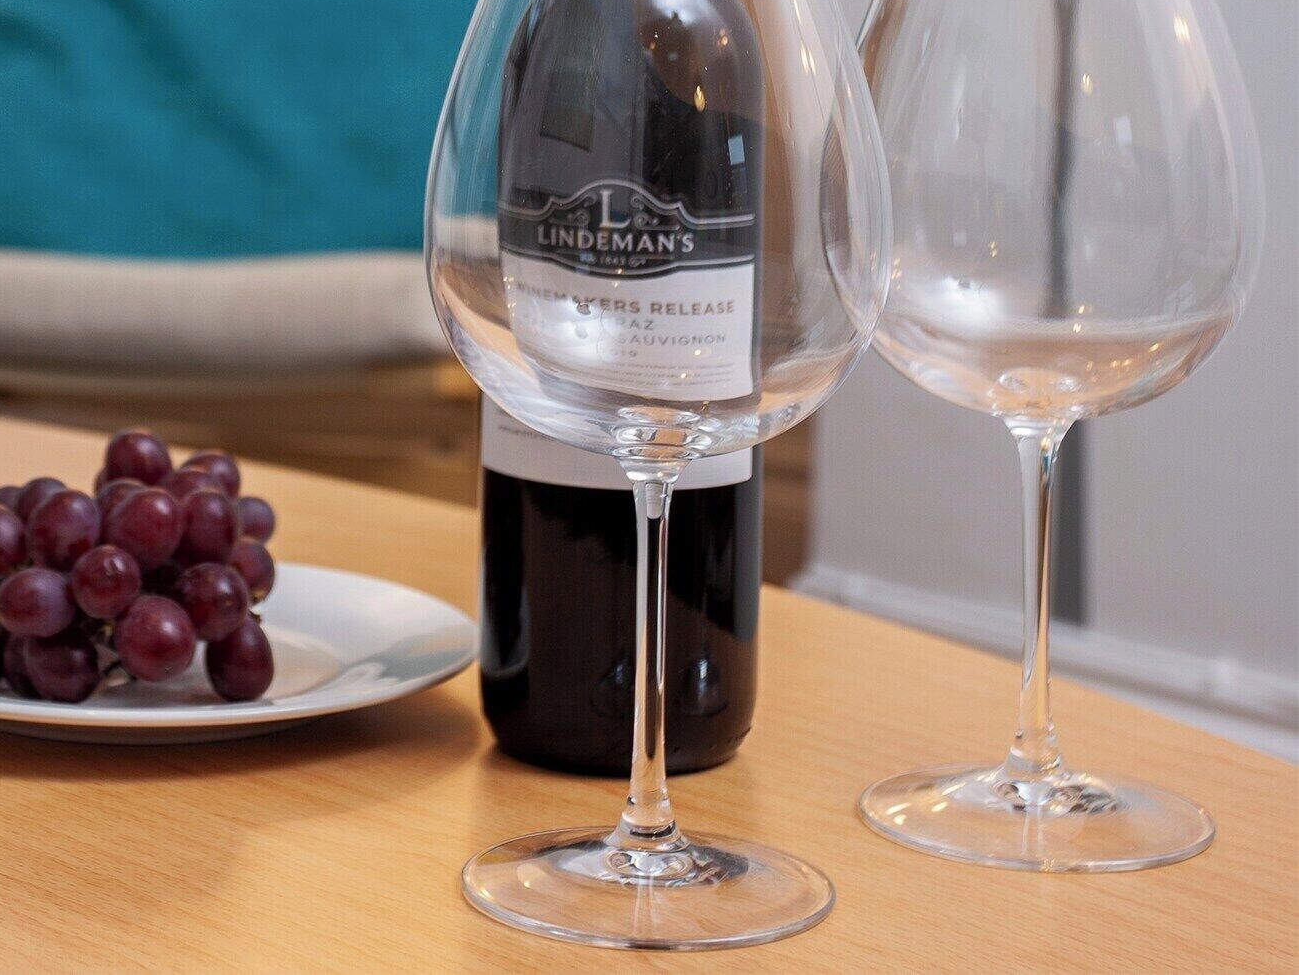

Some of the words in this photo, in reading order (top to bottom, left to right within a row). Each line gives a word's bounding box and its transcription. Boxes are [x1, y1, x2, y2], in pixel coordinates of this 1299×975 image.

[600, 189, 631, 228] L
[537, 225, 695, 253] LINDEMAN'S
[650, 299, 735, 316] RELEASE
